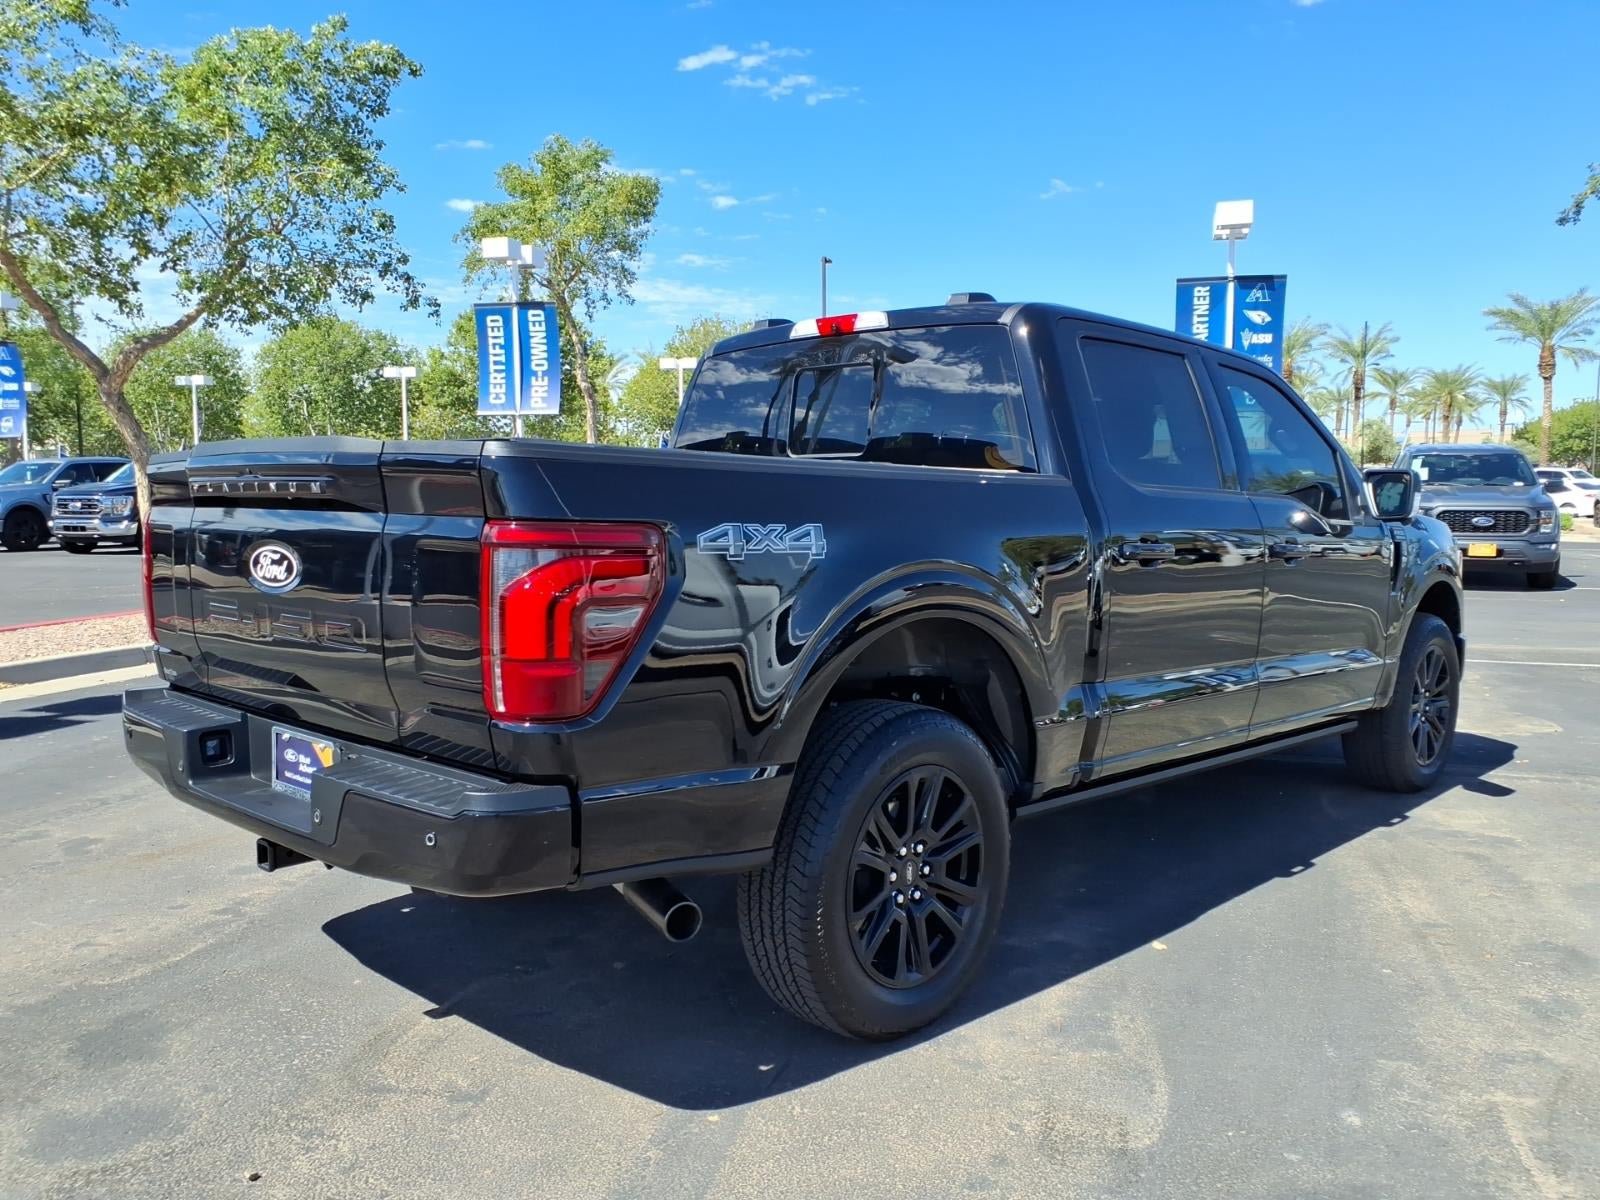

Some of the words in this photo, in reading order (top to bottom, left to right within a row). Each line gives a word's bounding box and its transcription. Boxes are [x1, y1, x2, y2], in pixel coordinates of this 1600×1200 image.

[1192, 286, 1210, 342] ARTNER
[486, 315, 506, 404] CERTIFIED
[527, 309, 549, 408] PRE-OWNED
[192, 481, 325, 494] PLATINUM
[256, 550, 289, 581] Ford
